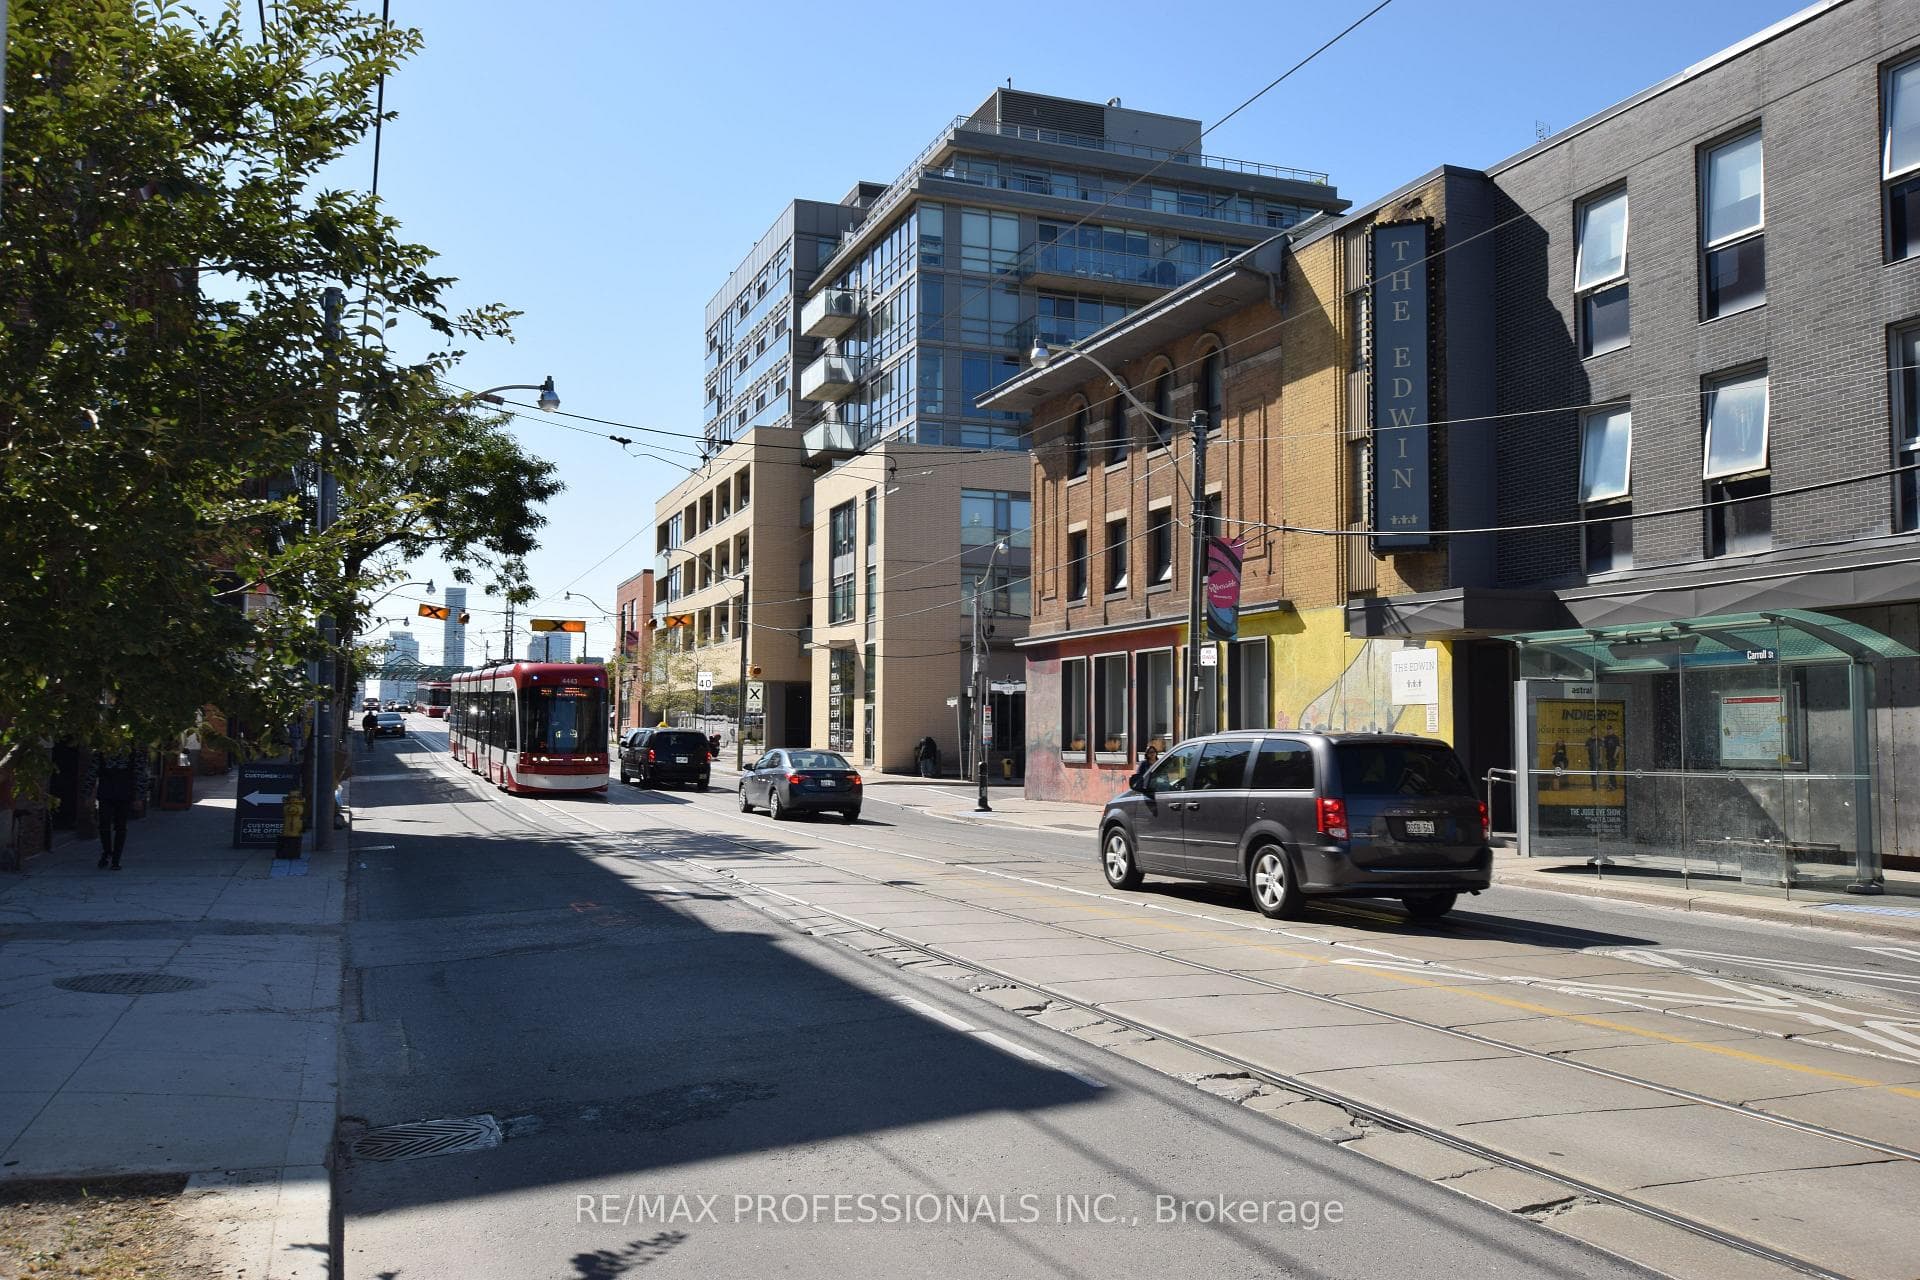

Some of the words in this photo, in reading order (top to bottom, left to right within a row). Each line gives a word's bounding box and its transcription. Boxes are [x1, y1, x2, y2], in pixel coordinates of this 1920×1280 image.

[1390, 240, 1412, 322] THE
[1388, 347, 1417, 490] EDWIN
[1747, 650, 1766, 660] Carroll
[1394, 663, 1408, 672] THE
[1409, 661, 1435, 672] EDWIN
[698, 679, 712, 688] 40
